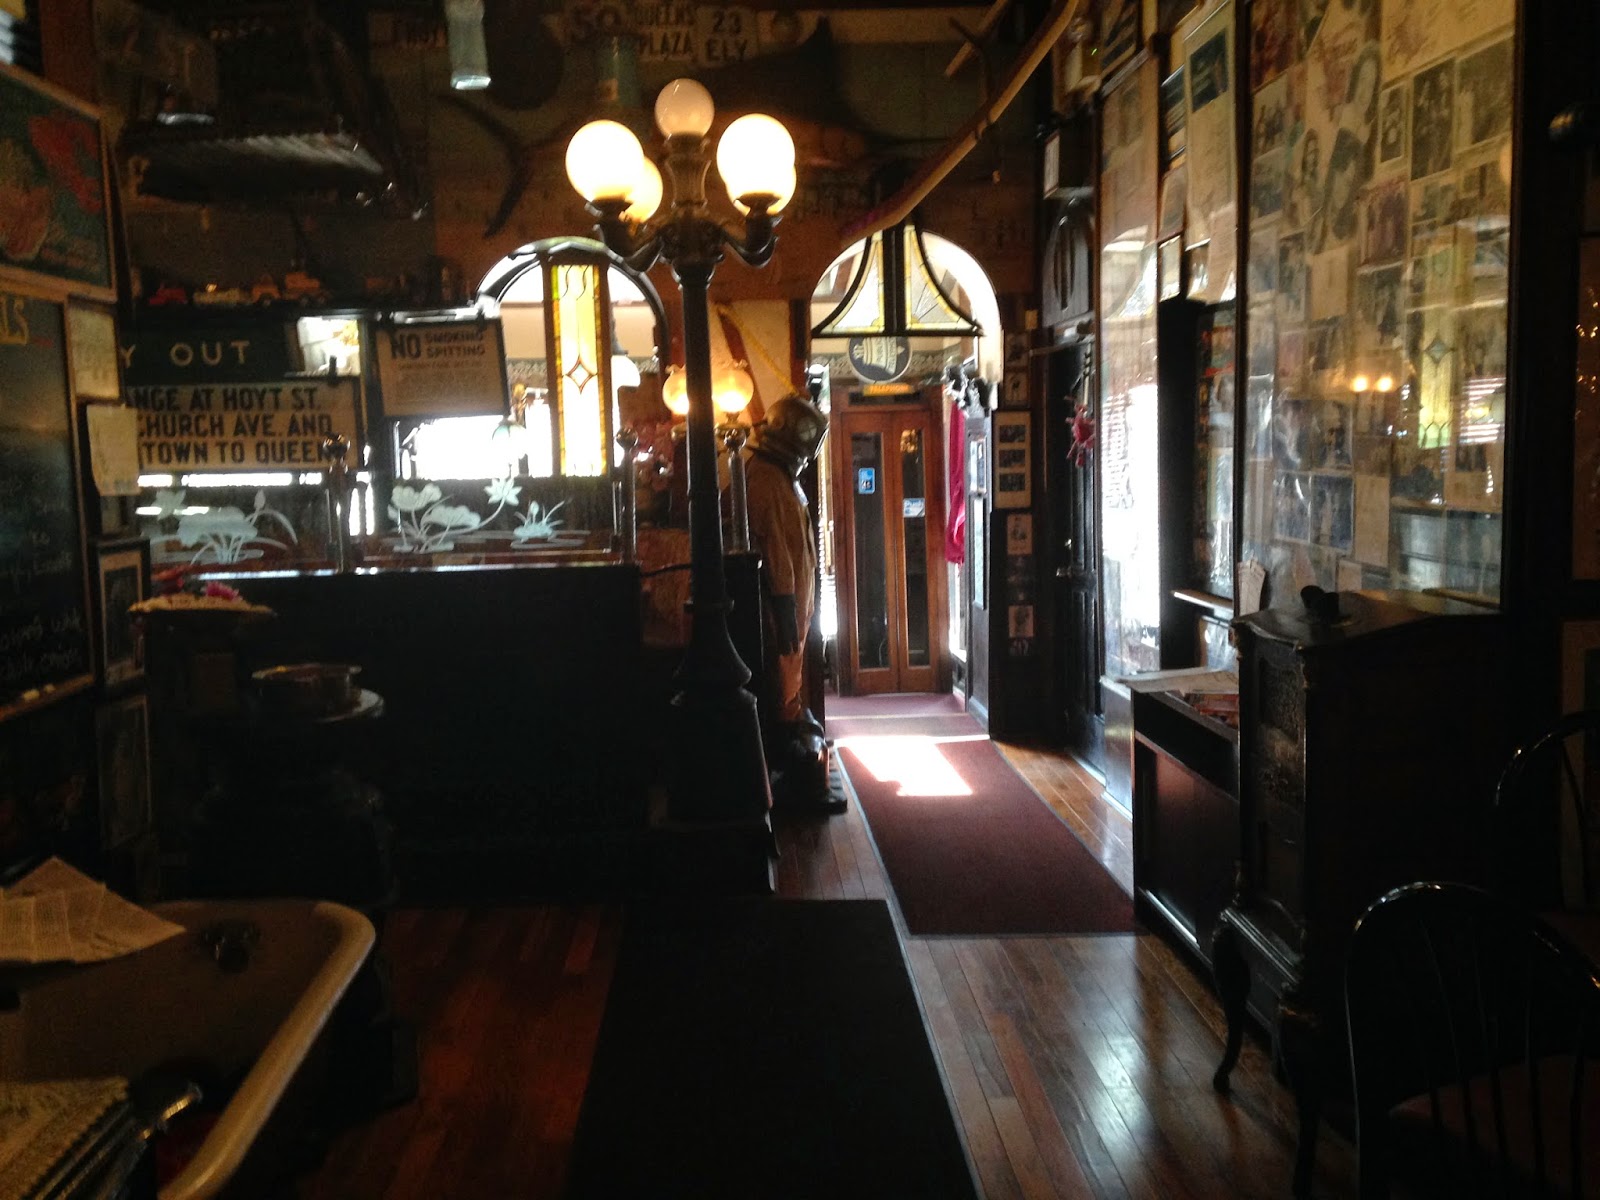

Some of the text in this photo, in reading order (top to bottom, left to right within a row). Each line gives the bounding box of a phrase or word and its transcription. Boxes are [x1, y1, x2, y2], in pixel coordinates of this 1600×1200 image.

[713, 10, 742, 34] 23
[639, 32, 693, 55] PLAZA
[706, 37, 748, 62] ELY
[170, 340, 250, 366] OUT
[392, 333, 422, 361] NO
[426, 344, 486, 359] SPITTING
[190, 387, 214, 411] AT
[222, 386, 281, 411] HOYT
[288, 412, 333, 437] AND
[143, 440, 339, 464] TOWN TO QUEEN
